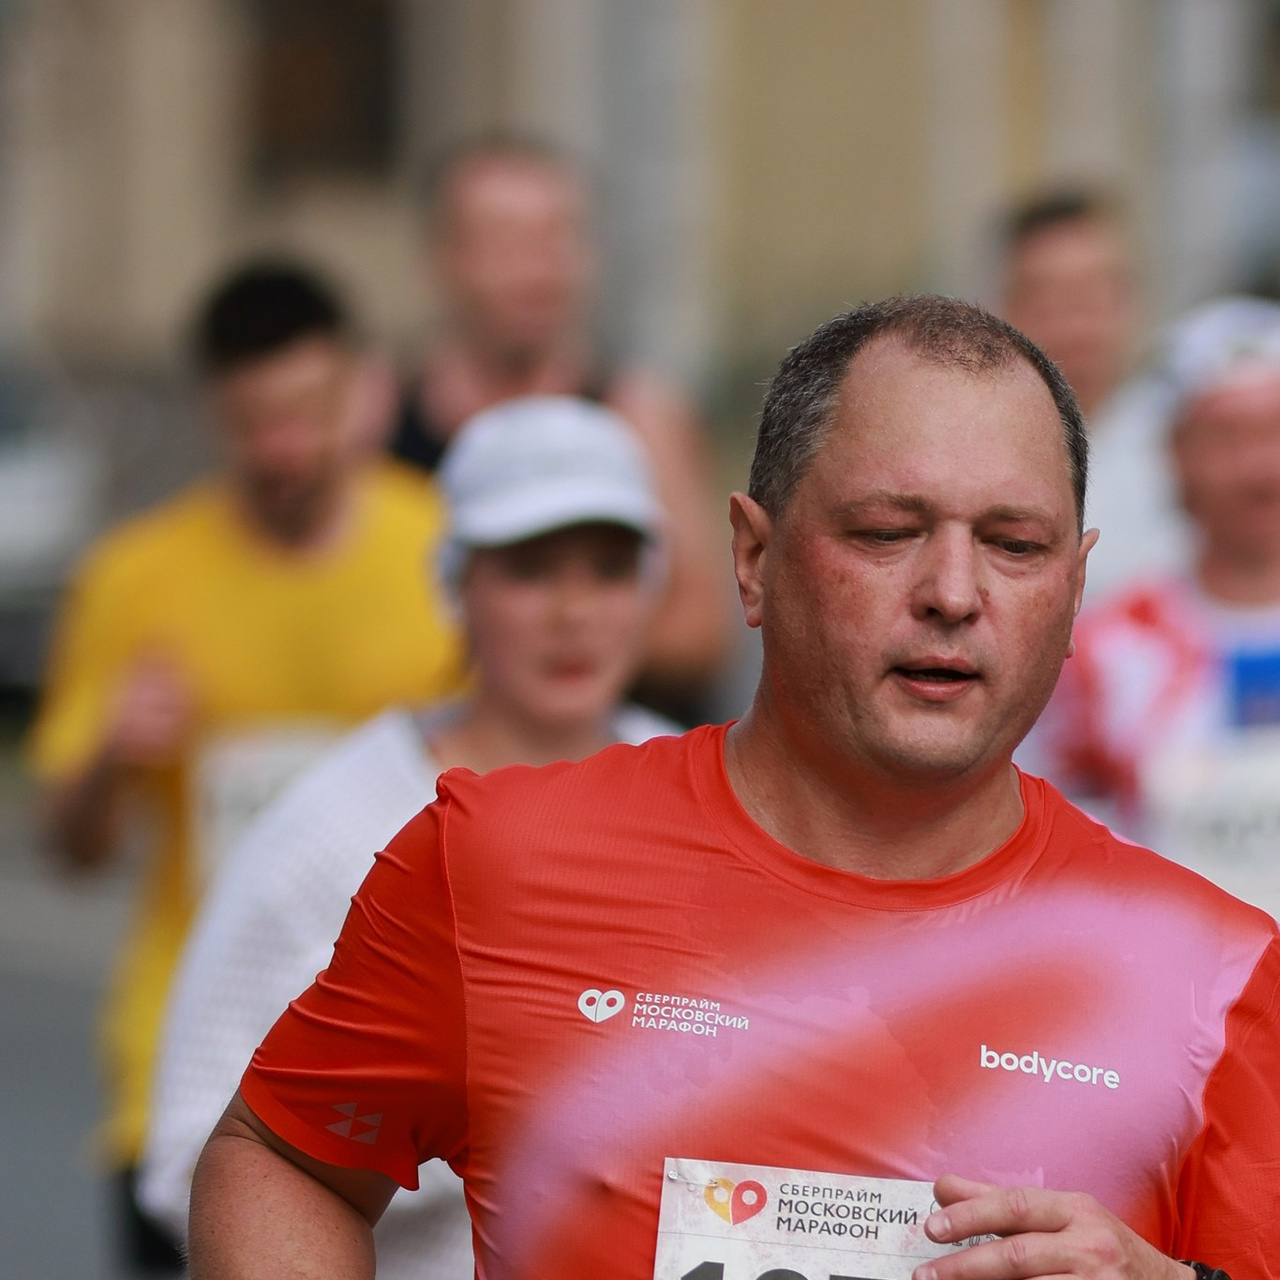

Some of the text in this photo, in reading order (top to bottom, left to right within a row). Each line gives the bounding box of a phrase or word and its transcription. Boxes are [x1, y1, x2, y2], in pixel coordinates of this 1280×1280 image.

[635, 992, 721, 1012] СБЕРПРАЙМ
[631, 1016, 718, 1037] МАРАФОН
[633, 1003, 750, 1030] МОСКОВСКИЙ
[979, 1045, 1120, 1089] bodycore
[779, 1183, 882, 1203] СБЕРПРАЙМ
[777, 1198, 918, 1225] МОСКОВСКИЙ
[776, 1217, 879, 1240] МАРАФОН
